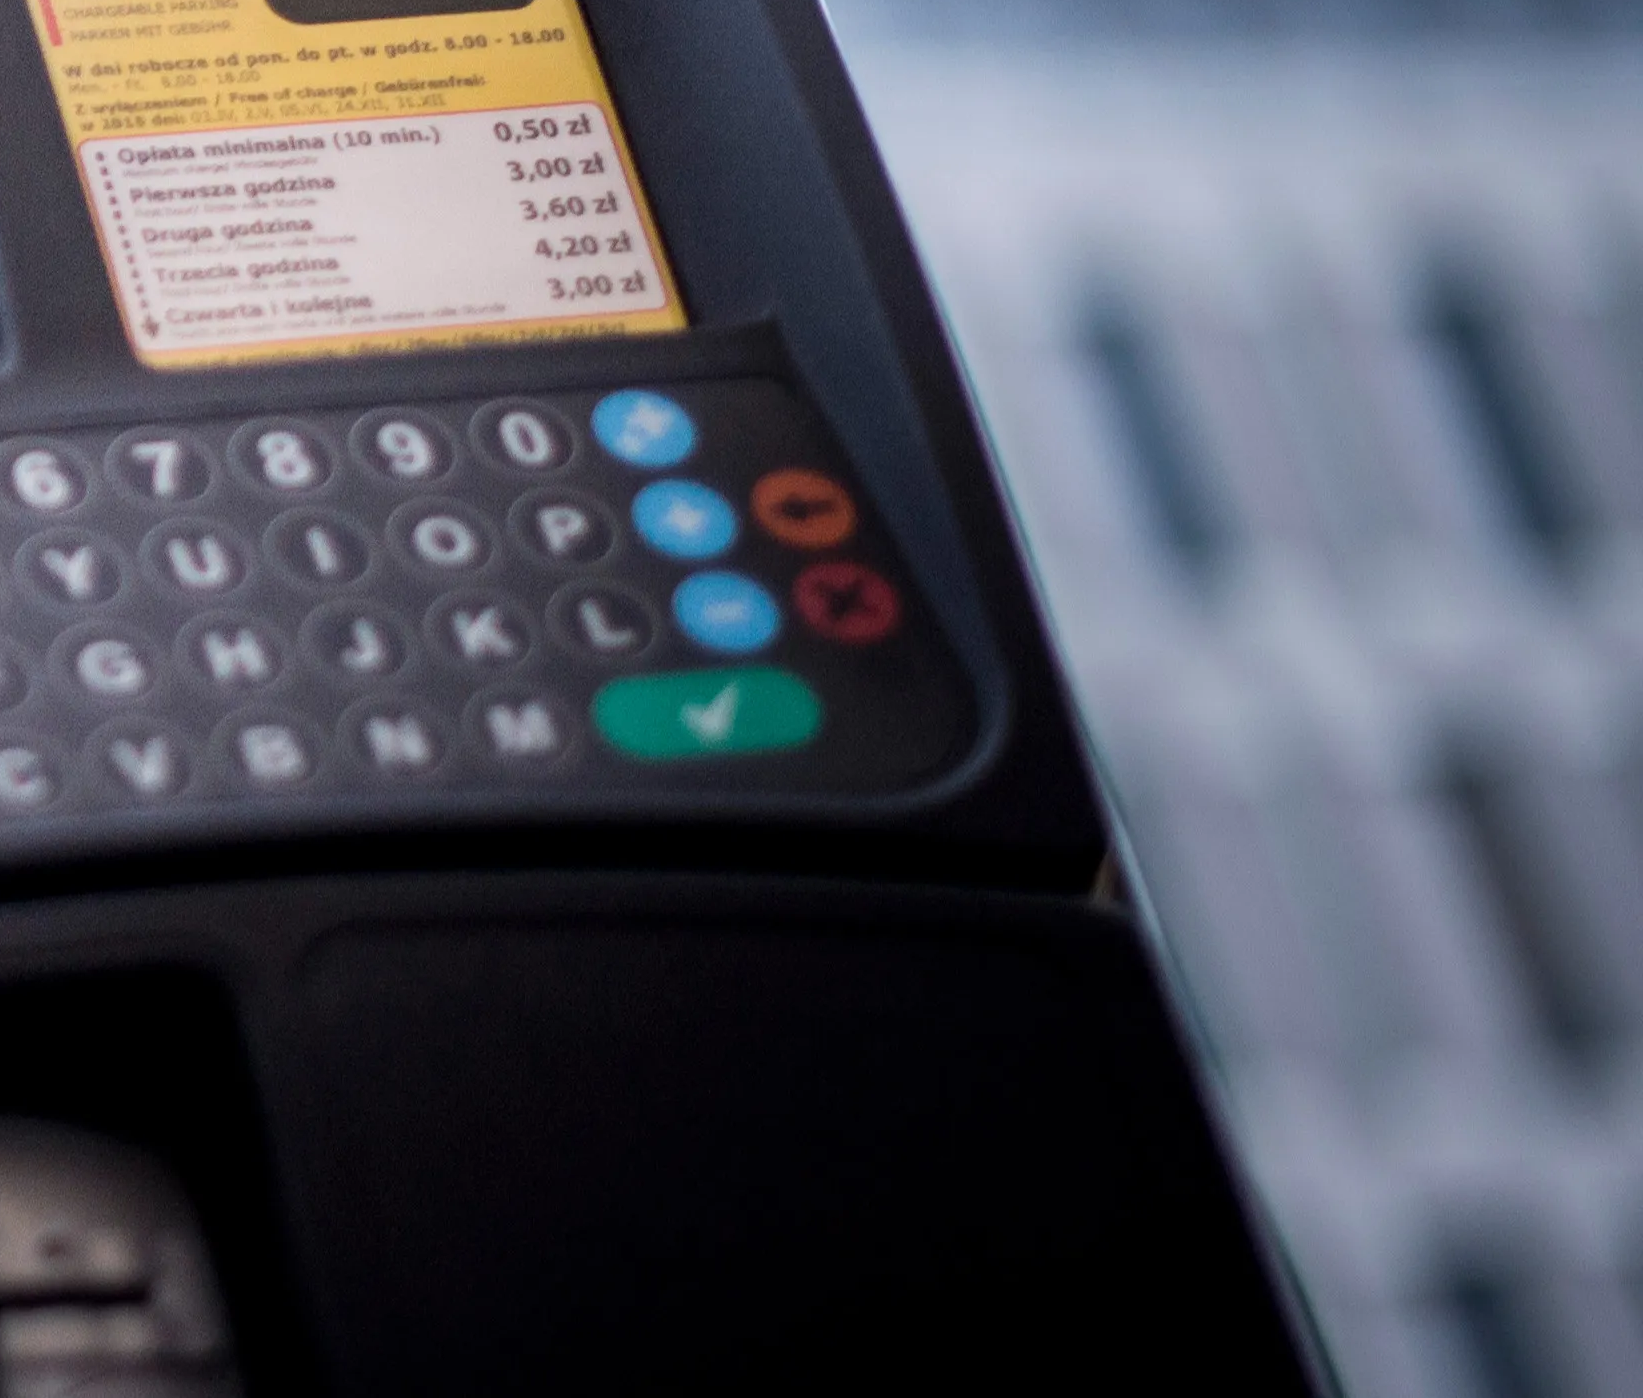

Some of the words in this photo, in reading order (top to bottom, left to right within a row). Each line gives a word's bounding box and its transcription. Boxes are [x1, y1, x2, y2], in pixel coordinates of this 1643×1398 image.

[90, 62, 122, 77] dni
[128, 57, 208, 74] robocze
[215, 53, 240, 67] od
[246, 51, 290, 69] pon.
[296, 47, 320, 62] do
[328, 46, 354, 62] pt.
[360, 46, 377, 57] w
[384, 39, 438, 59] godz.
[510, 28, 565, 46] 18.00
[117, 144, 195, 166] Opłata
[203, 135, 325, 158] minimalna
[333, 130, 372, 152] (10
[380, 125, 441, 145] min.)
[493, 118, 559, 144] 0,50
[565, 112, 592, 136] zł
[129, 182, 236, 203] Pierwsza
[243, 175, 336, 198] godzina
[506, 157, 571, 182] 3,00
[578, 151, 605, 175] zł
[141, 224, 214, 244] Druga
[221, 216, 313, 240] godzina
[518, 196, 584, 221] 3,60
[591, 190, 618, 214] zł
[153, 263, 240, 283] Trzecia
[245, 255, 340, 279] godzina
[534, 234, 598, 260] 4,20
[605, 229, 633, 253] zł
[165, 304, 263, 324] Czwarta
[548, 274, 613, 300] 3,00
[619, 269, 646, 293] zł
[13, 450, 71, 511] 6
[132, 439, 181, 498] 7
[257, 430, 315, 489] 8
[377, 421, 434, 479] 9
[499, 410, 554, 468] 0
[41, 547, 93, 596] Y
[168, 537, 230, 590] U
[306, 527, 339, 576] I
[413, 515, 476, 567] O
[537, 507, 587, 555] P
[77, 639, 144, 695] G
[205, 631, 267, 681] H
[346, 620, 384, 673] J
[454, 609, 512, 658] K
[579, 599, 633, 651] L
[111, 739, 169, 792] V
[241, 725, 304, 782] B
[368, 718, 430, 765] N
[488, 702, 555, 755] M
